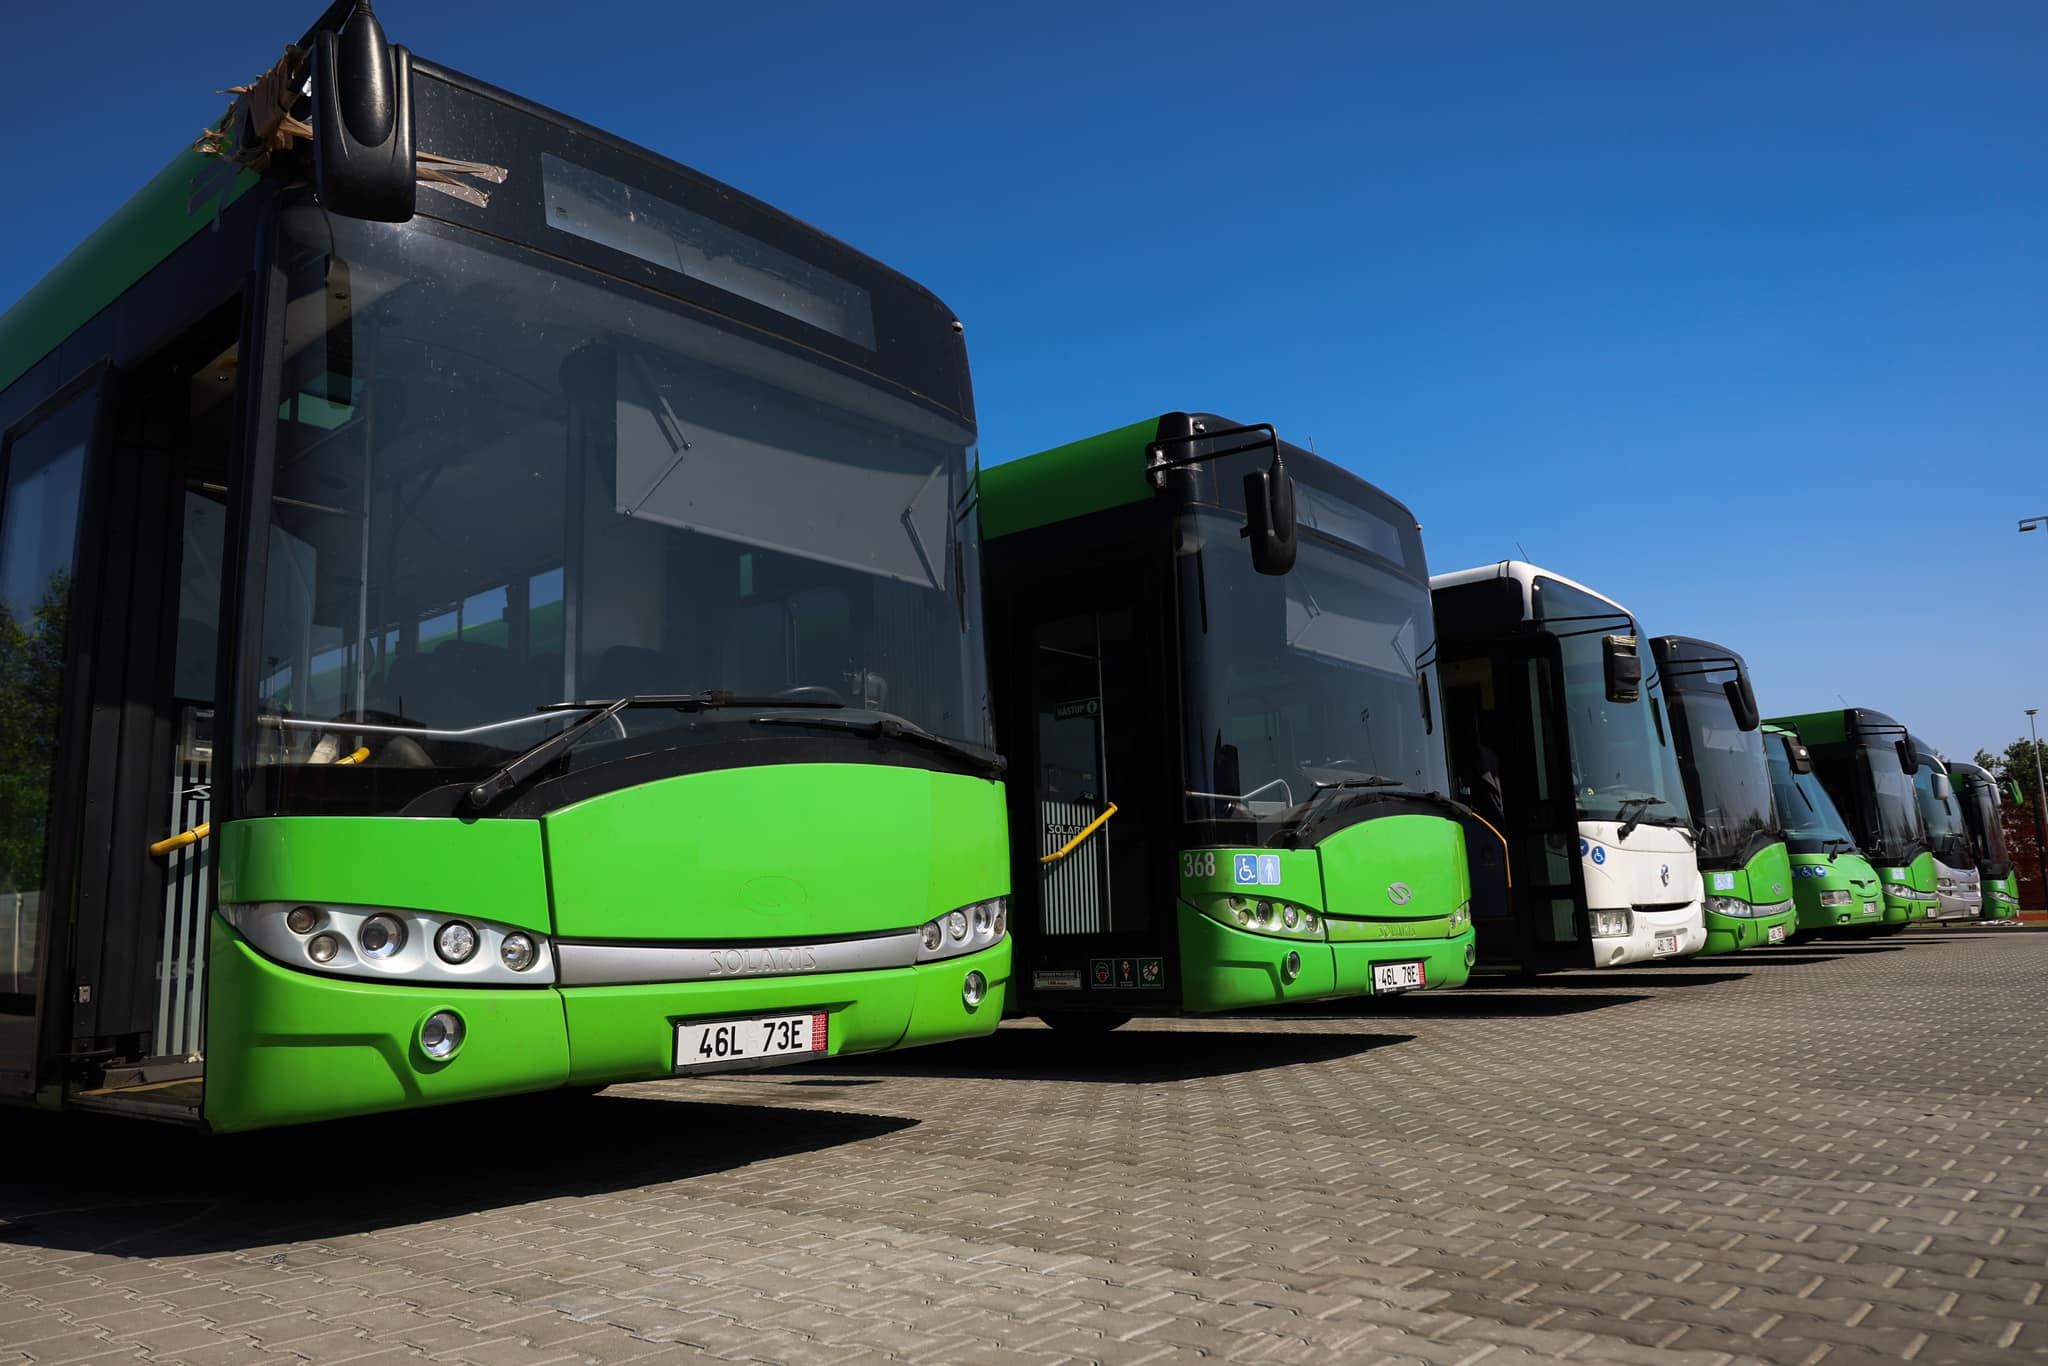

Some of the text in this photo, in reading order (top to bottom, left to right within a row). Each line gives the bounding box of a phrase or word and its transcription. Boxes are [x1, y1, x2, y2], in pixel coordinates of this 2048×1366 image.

[1184, 852, 1216, 878] 368
[709, 947, 817, 975] SOLARIS
[1382, 968, 1397, 986] 46L
[699, 1020, 803, 1058] 46L 73E
